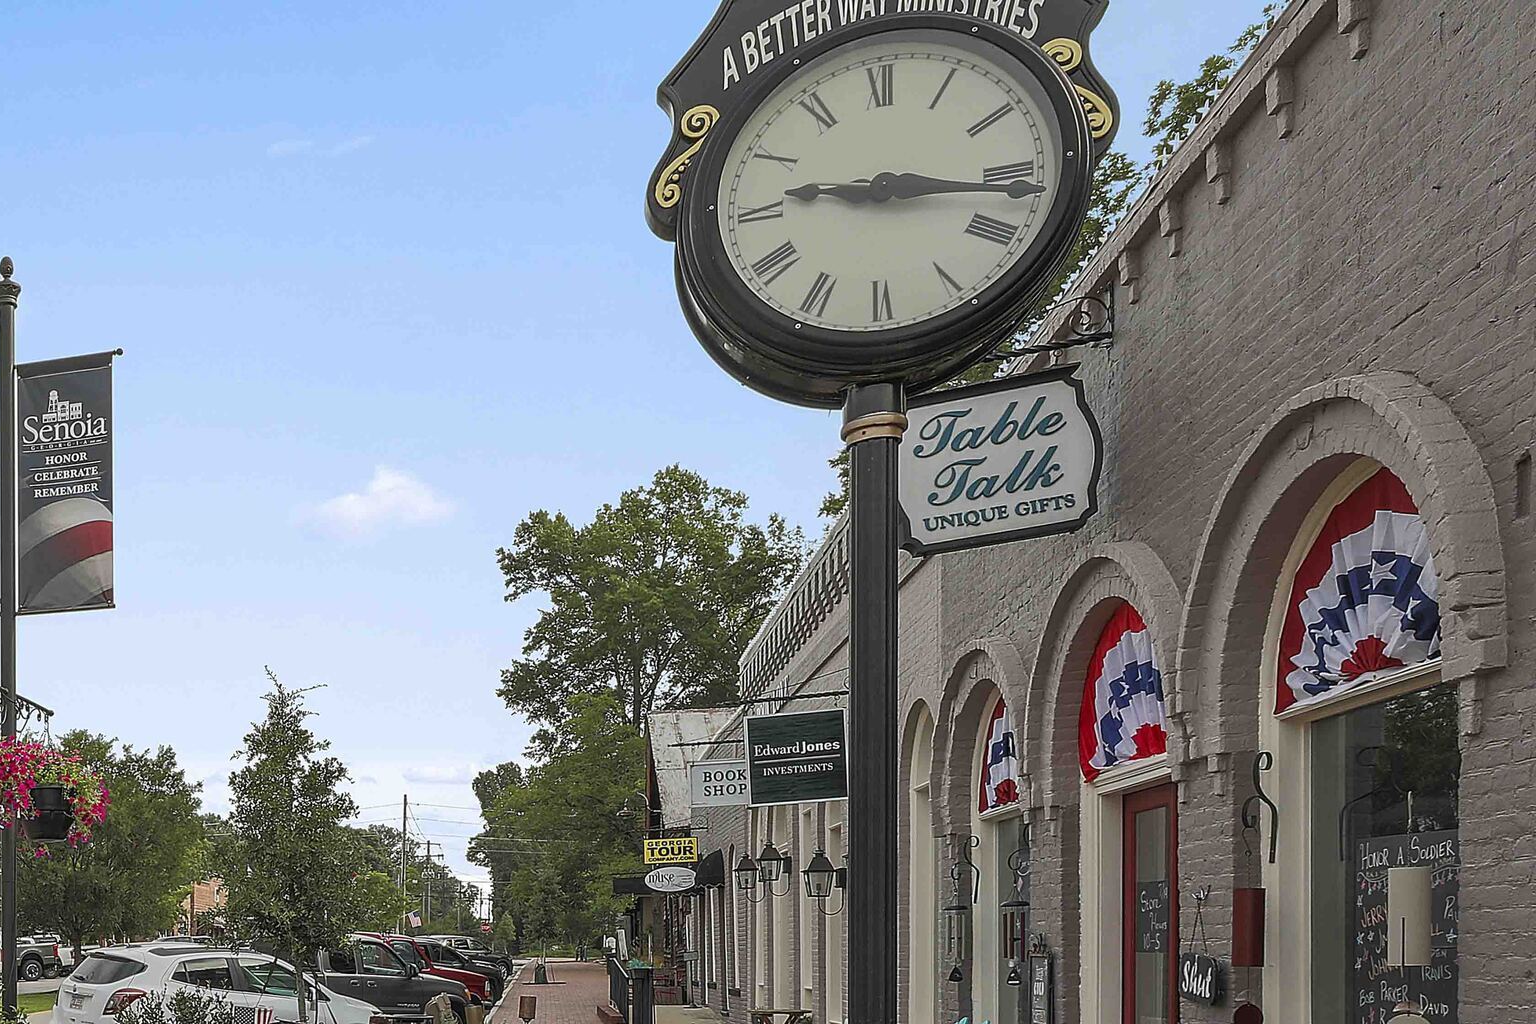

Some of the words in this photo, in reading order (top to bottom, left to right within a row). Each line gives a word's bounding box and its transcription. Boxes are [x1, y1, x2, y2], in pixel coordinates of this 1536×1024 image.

[723, 46, 741, 91] A
[740, 0, 832, 74] BETTER
[23, 413, 108, 444] Senoia
[913, 396, 1067, 458] Table
[45, 452, 88, 465] HONOR
[34, 466, 99, 482] CELEBRATE
[927, 445, 1064, 506] Talk
[34, 482, 99, 498] REMEMBER
[923, 505, 1010, 531] UNIQUE
[1015, 493, 1076, 517] GIFTS
[754, 742, 800, 757] Edward
[801, 740, 840, 754] Jones
[703, 769, 747, 783] BOOK
[763, 762, 834, 776] INVESTMENTS
[704, 783, 747, 797] SHOP
[647, 846, 695, 857] TOUR
[1397, 846, 1404, 865] A
[1182, 954, 1212, 998] Shut
[1419, 993, 1449, 1016] DAVID
